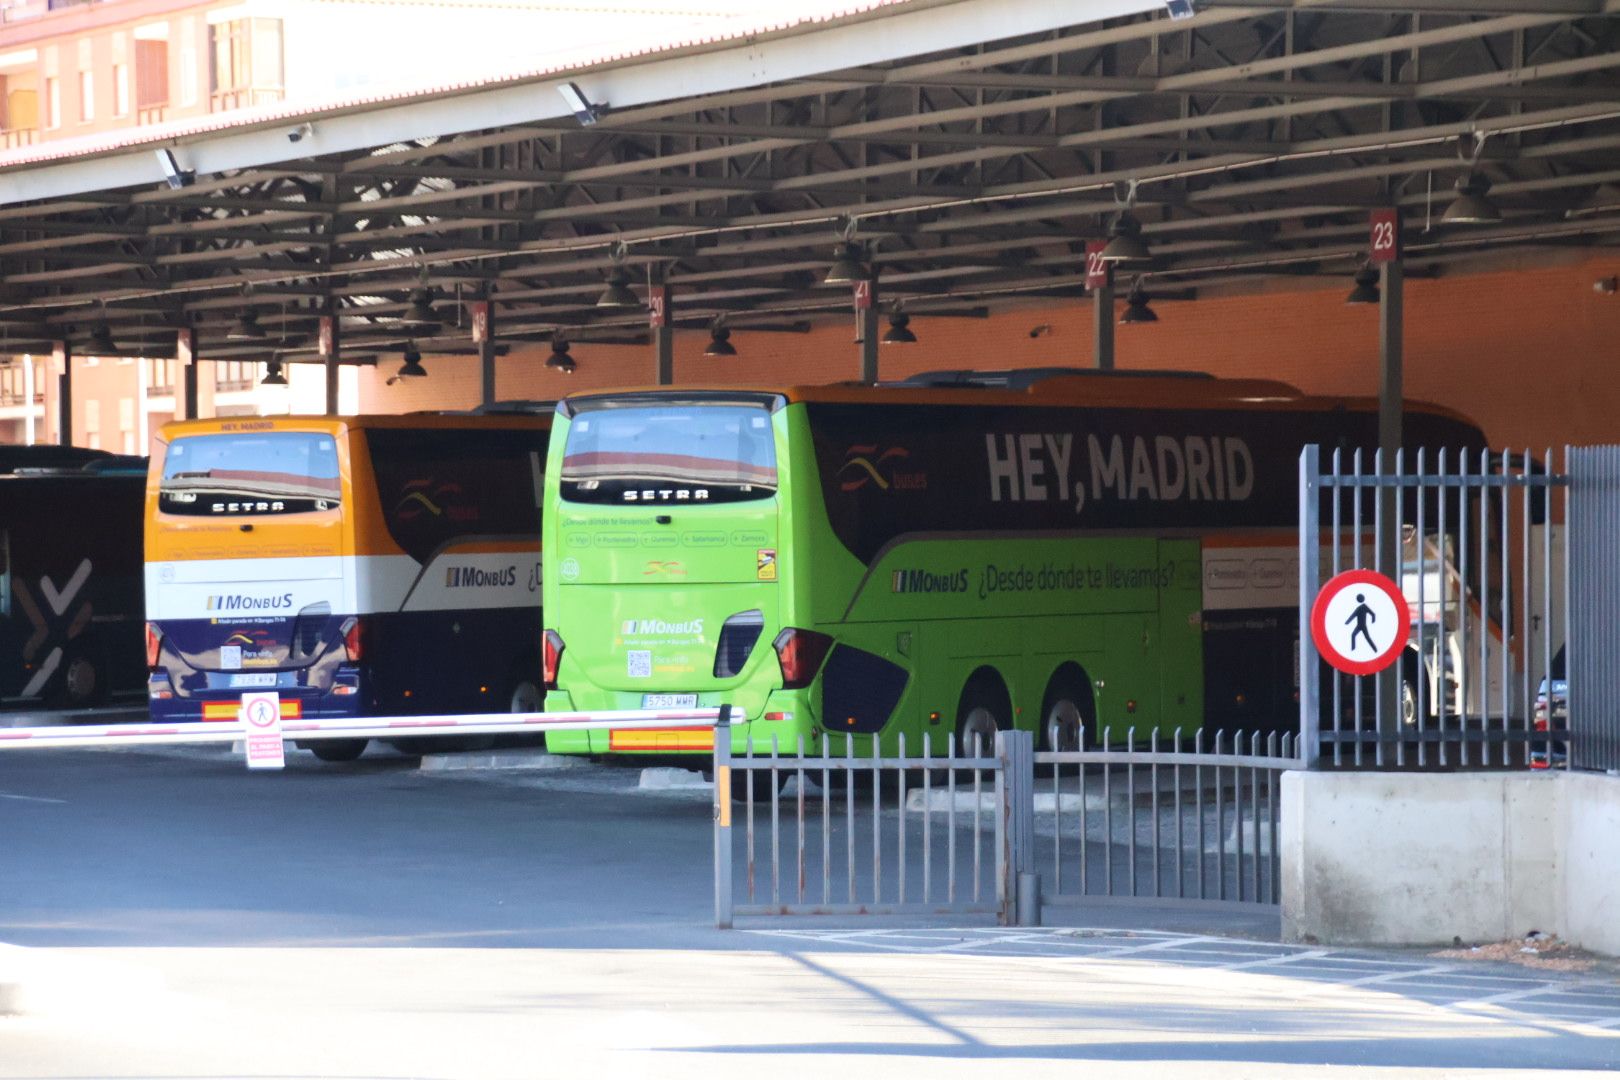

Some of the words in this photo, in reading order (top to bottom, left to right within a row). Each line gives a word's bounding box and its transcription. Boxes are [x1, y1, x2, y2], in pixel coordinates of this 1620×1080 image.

[1374, 221, 1393, 250] 23
[1089, 251, 1105, 276] 22
[985, 433, 1085, 514] HEY,
[1087, 433, 1254, 500] MADRID
[212, 502, 284, 512] SETRA
[624, 489, 709, 500] SETRA
[978, 563, 1033, 599] ¿Desde
[1037, 563, 1083, 591] dónde
[1087, 568, 1102, 589] te
[1106, 559, 1176, 589] llevamos?
